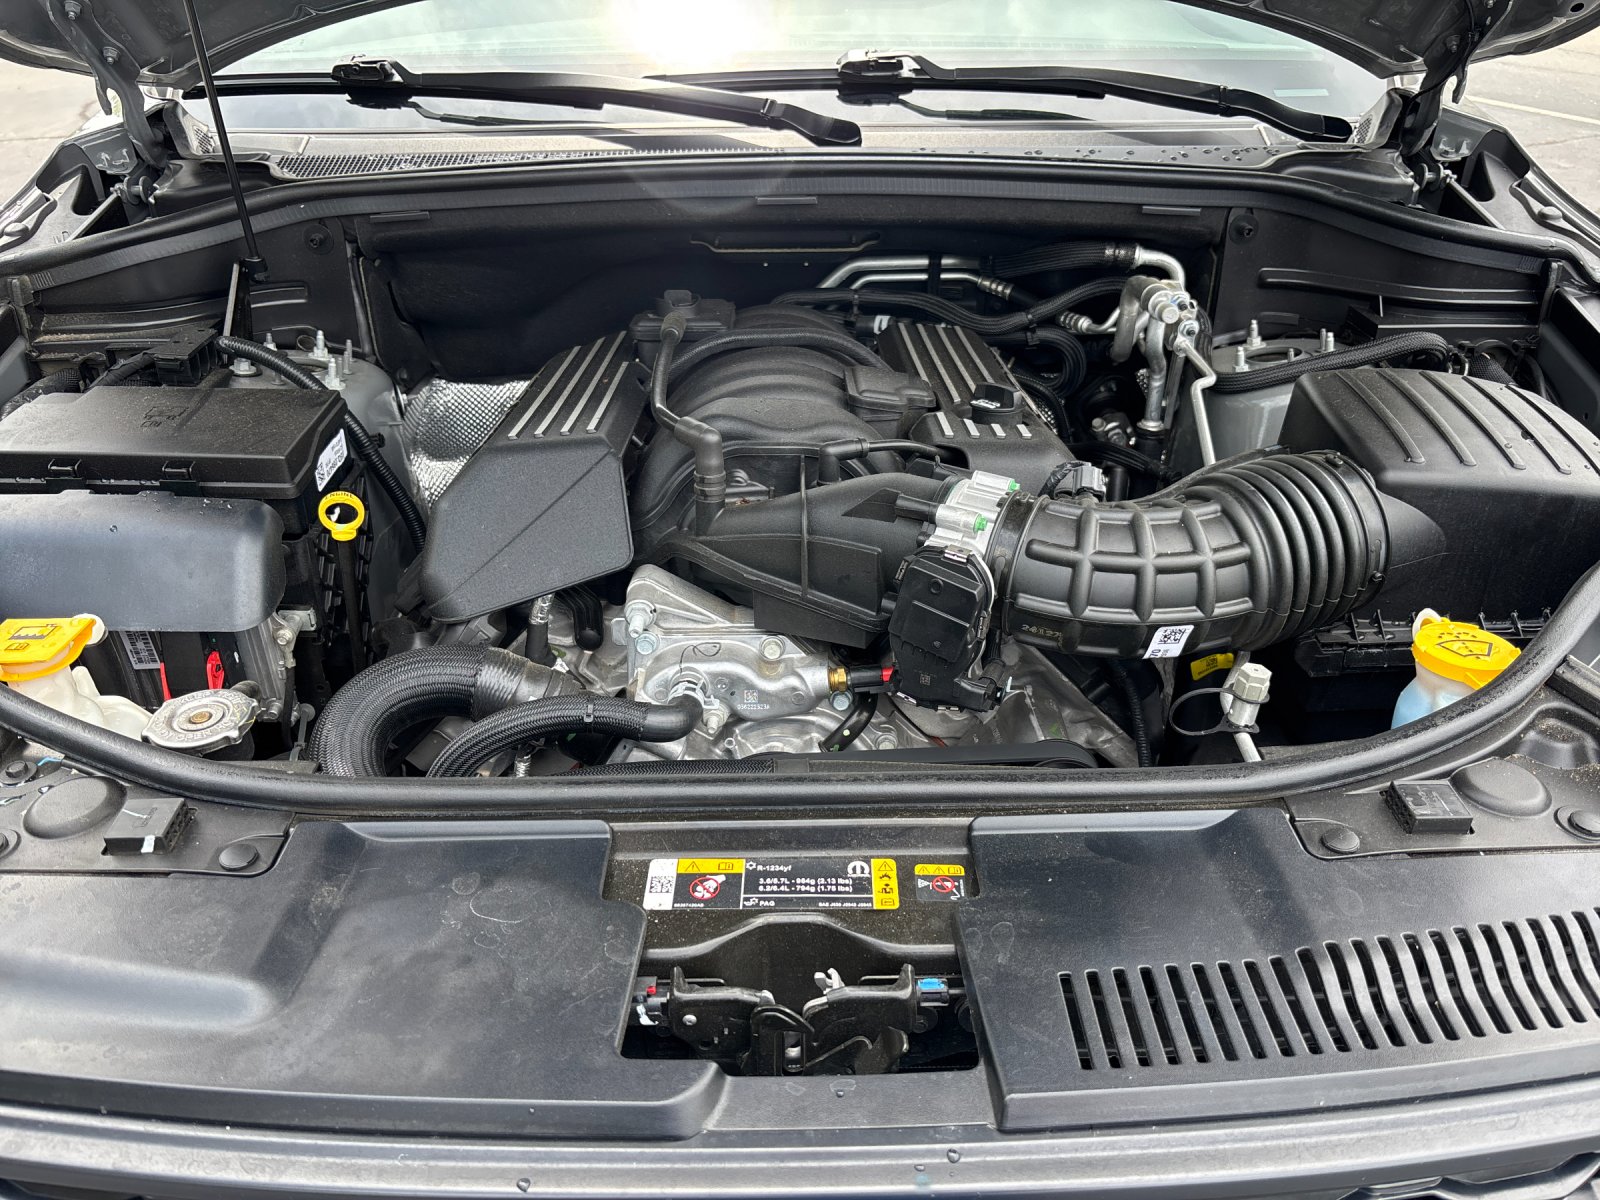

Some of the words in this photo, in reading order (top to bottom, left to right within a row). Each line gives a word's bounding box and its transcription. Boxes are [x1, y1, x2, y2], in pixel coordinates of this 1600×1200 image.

[756, 864, 792, 873] R-1234yf
[817, 877, 836, 886] (2.13
[837, 877, 853, 886] lbs)
[837, 885, 853, 893] lbs)
